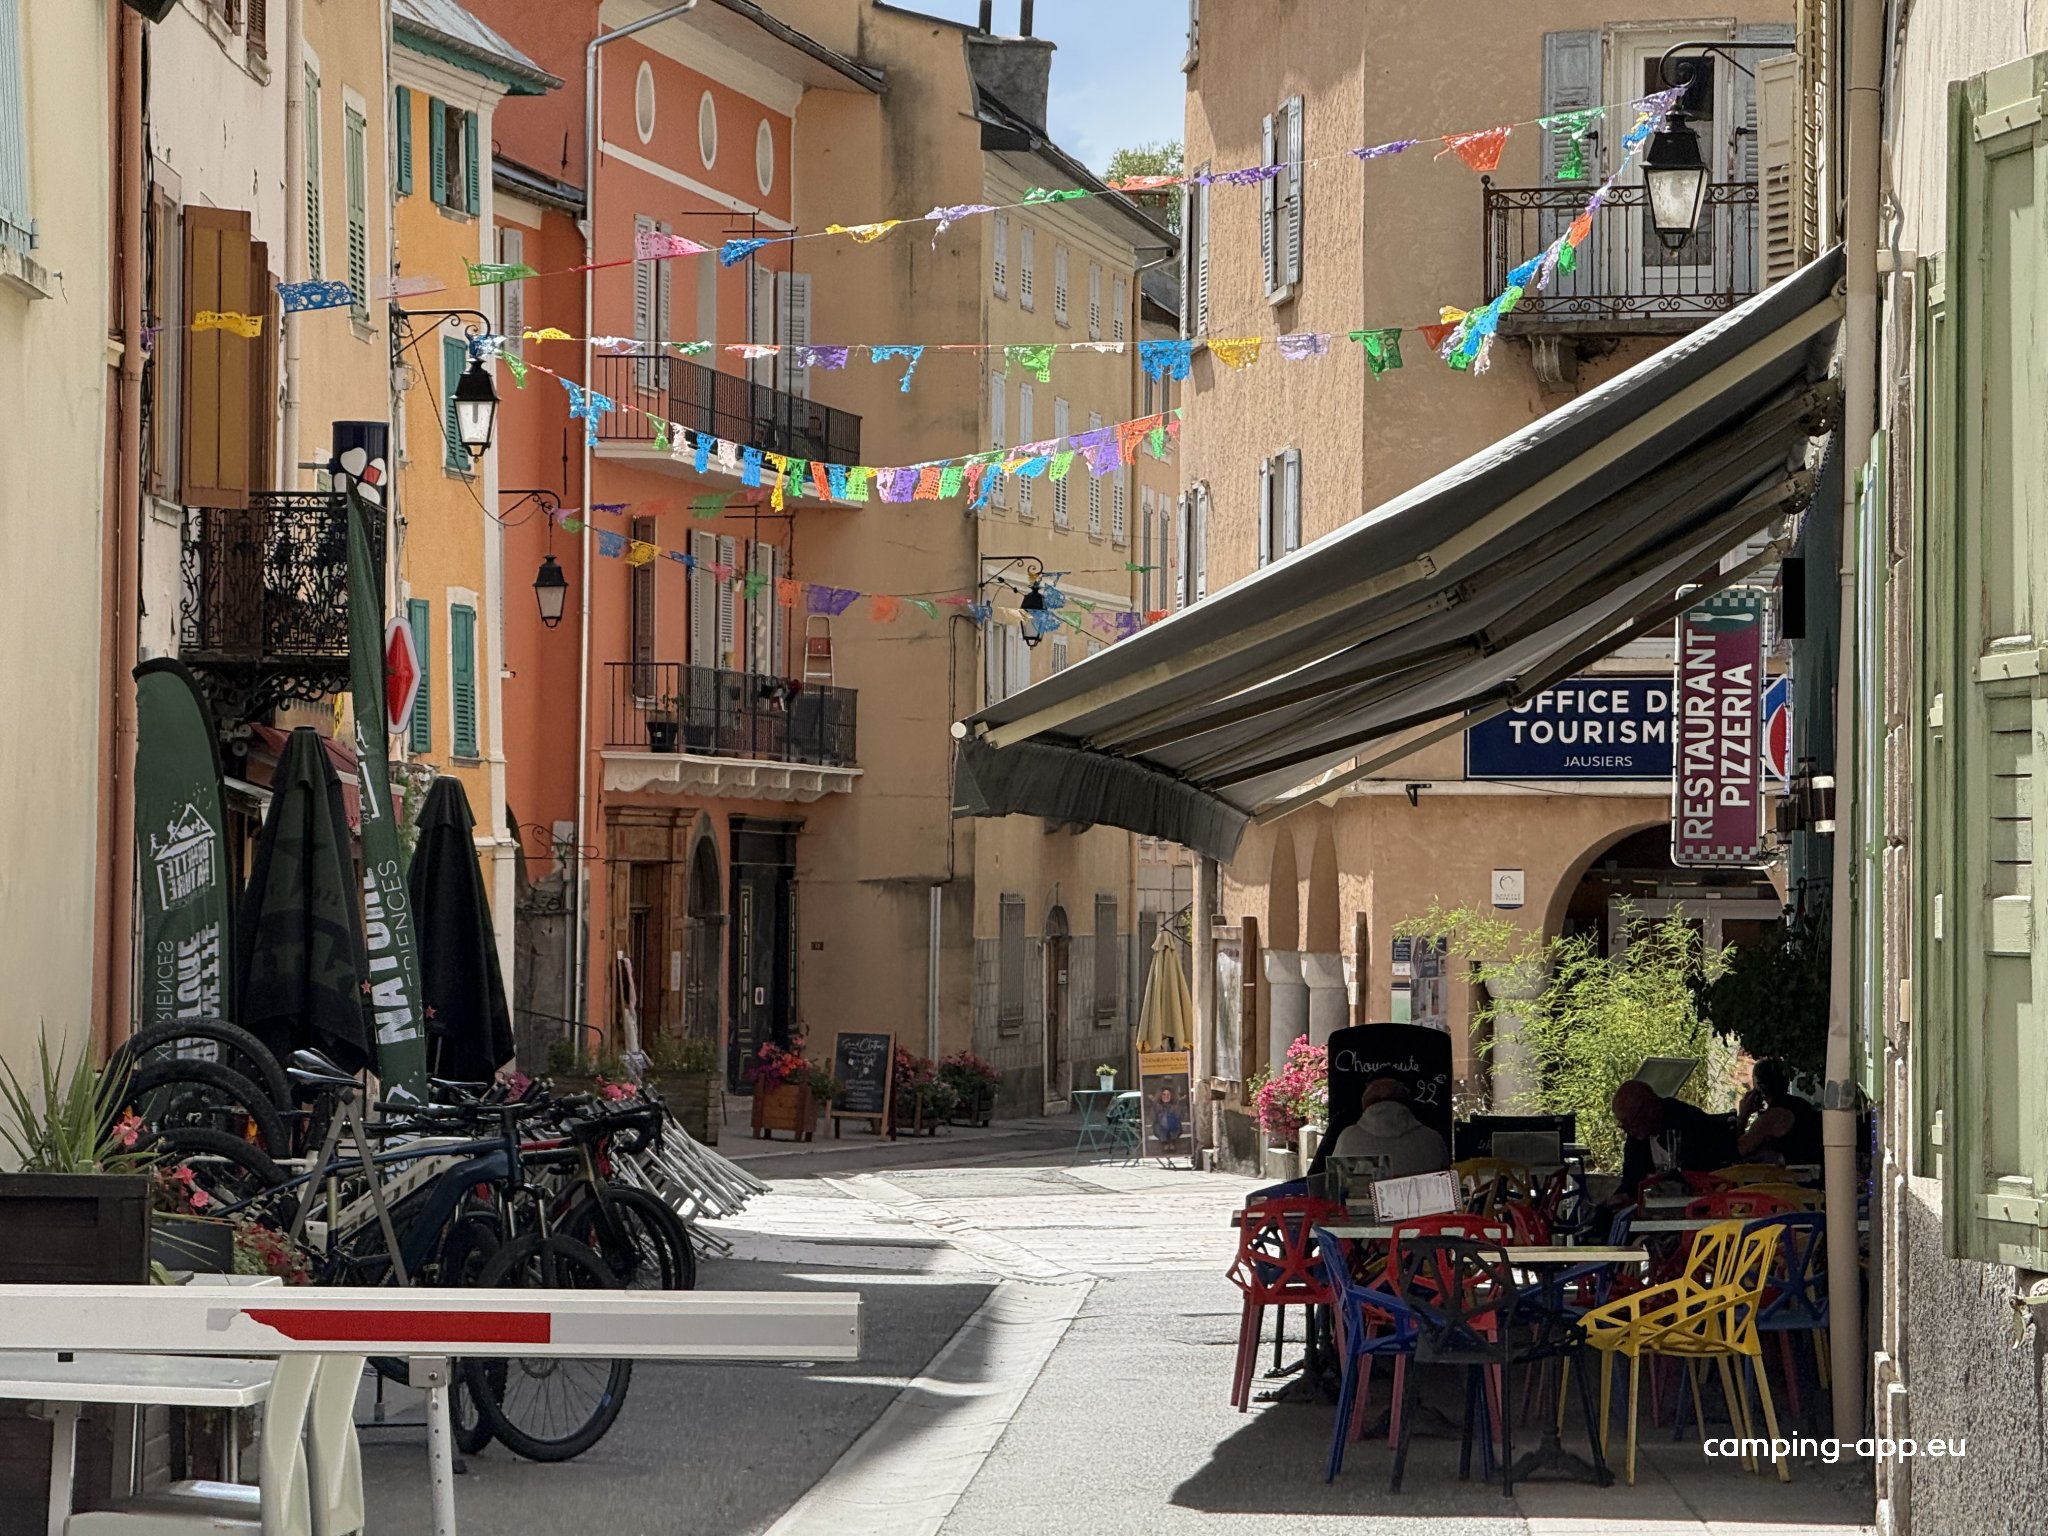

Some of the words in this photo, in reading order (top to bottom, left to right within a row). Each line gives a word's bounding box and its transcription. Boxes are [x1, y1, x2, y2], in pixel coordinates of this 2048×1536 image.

[1563, 755, 1633, 767] JAUSIERS
[1683, 628, 1716, 839] RESTAURANT
[1720, 663, 1752, 807] PIZZERIA
[377, 859, 425, 1038] RIENCES
[1334, 1049, 1421, 1073] Chouute
